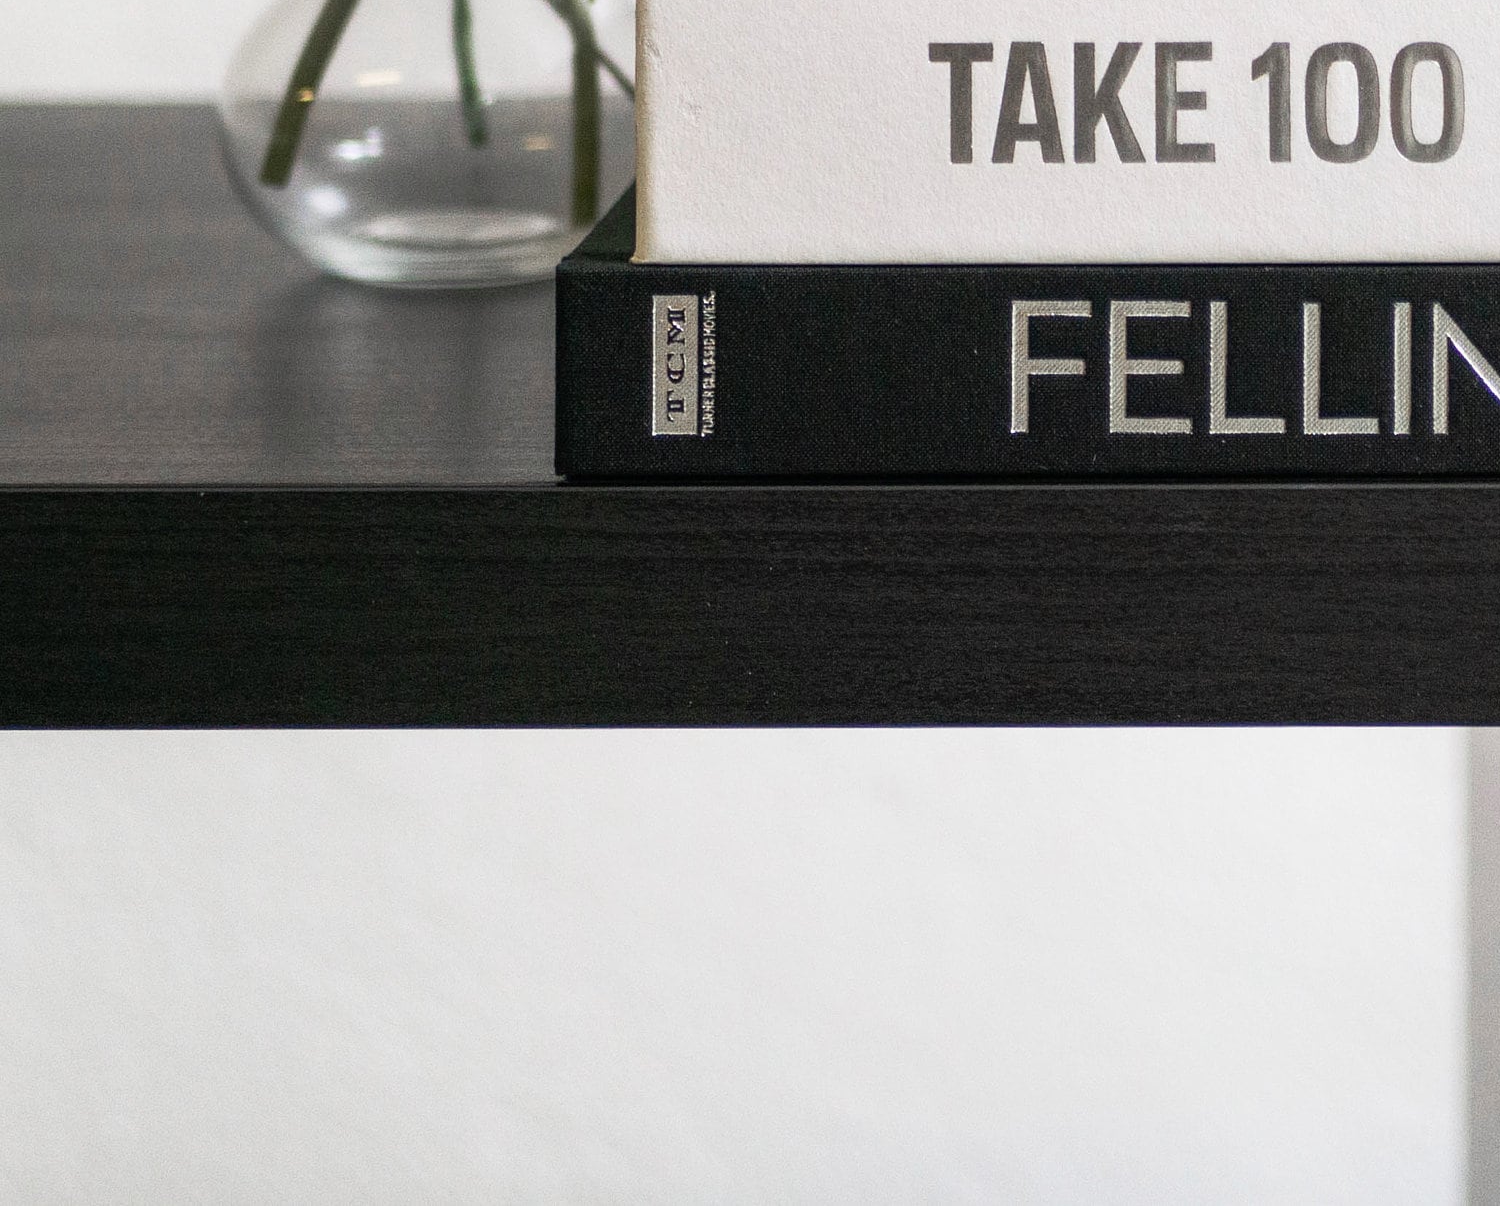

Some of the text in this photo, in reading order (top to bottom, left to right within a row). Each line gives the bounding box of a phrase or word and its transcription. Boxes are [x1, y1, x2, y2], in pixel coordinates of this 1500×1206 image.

[928, 41, 1464, 164] TAKE 100
[666, 305, 687, 423] TCM
[701, 338, 716, 389] CLASSIC
[700, 390, 716, 438] TURNER
